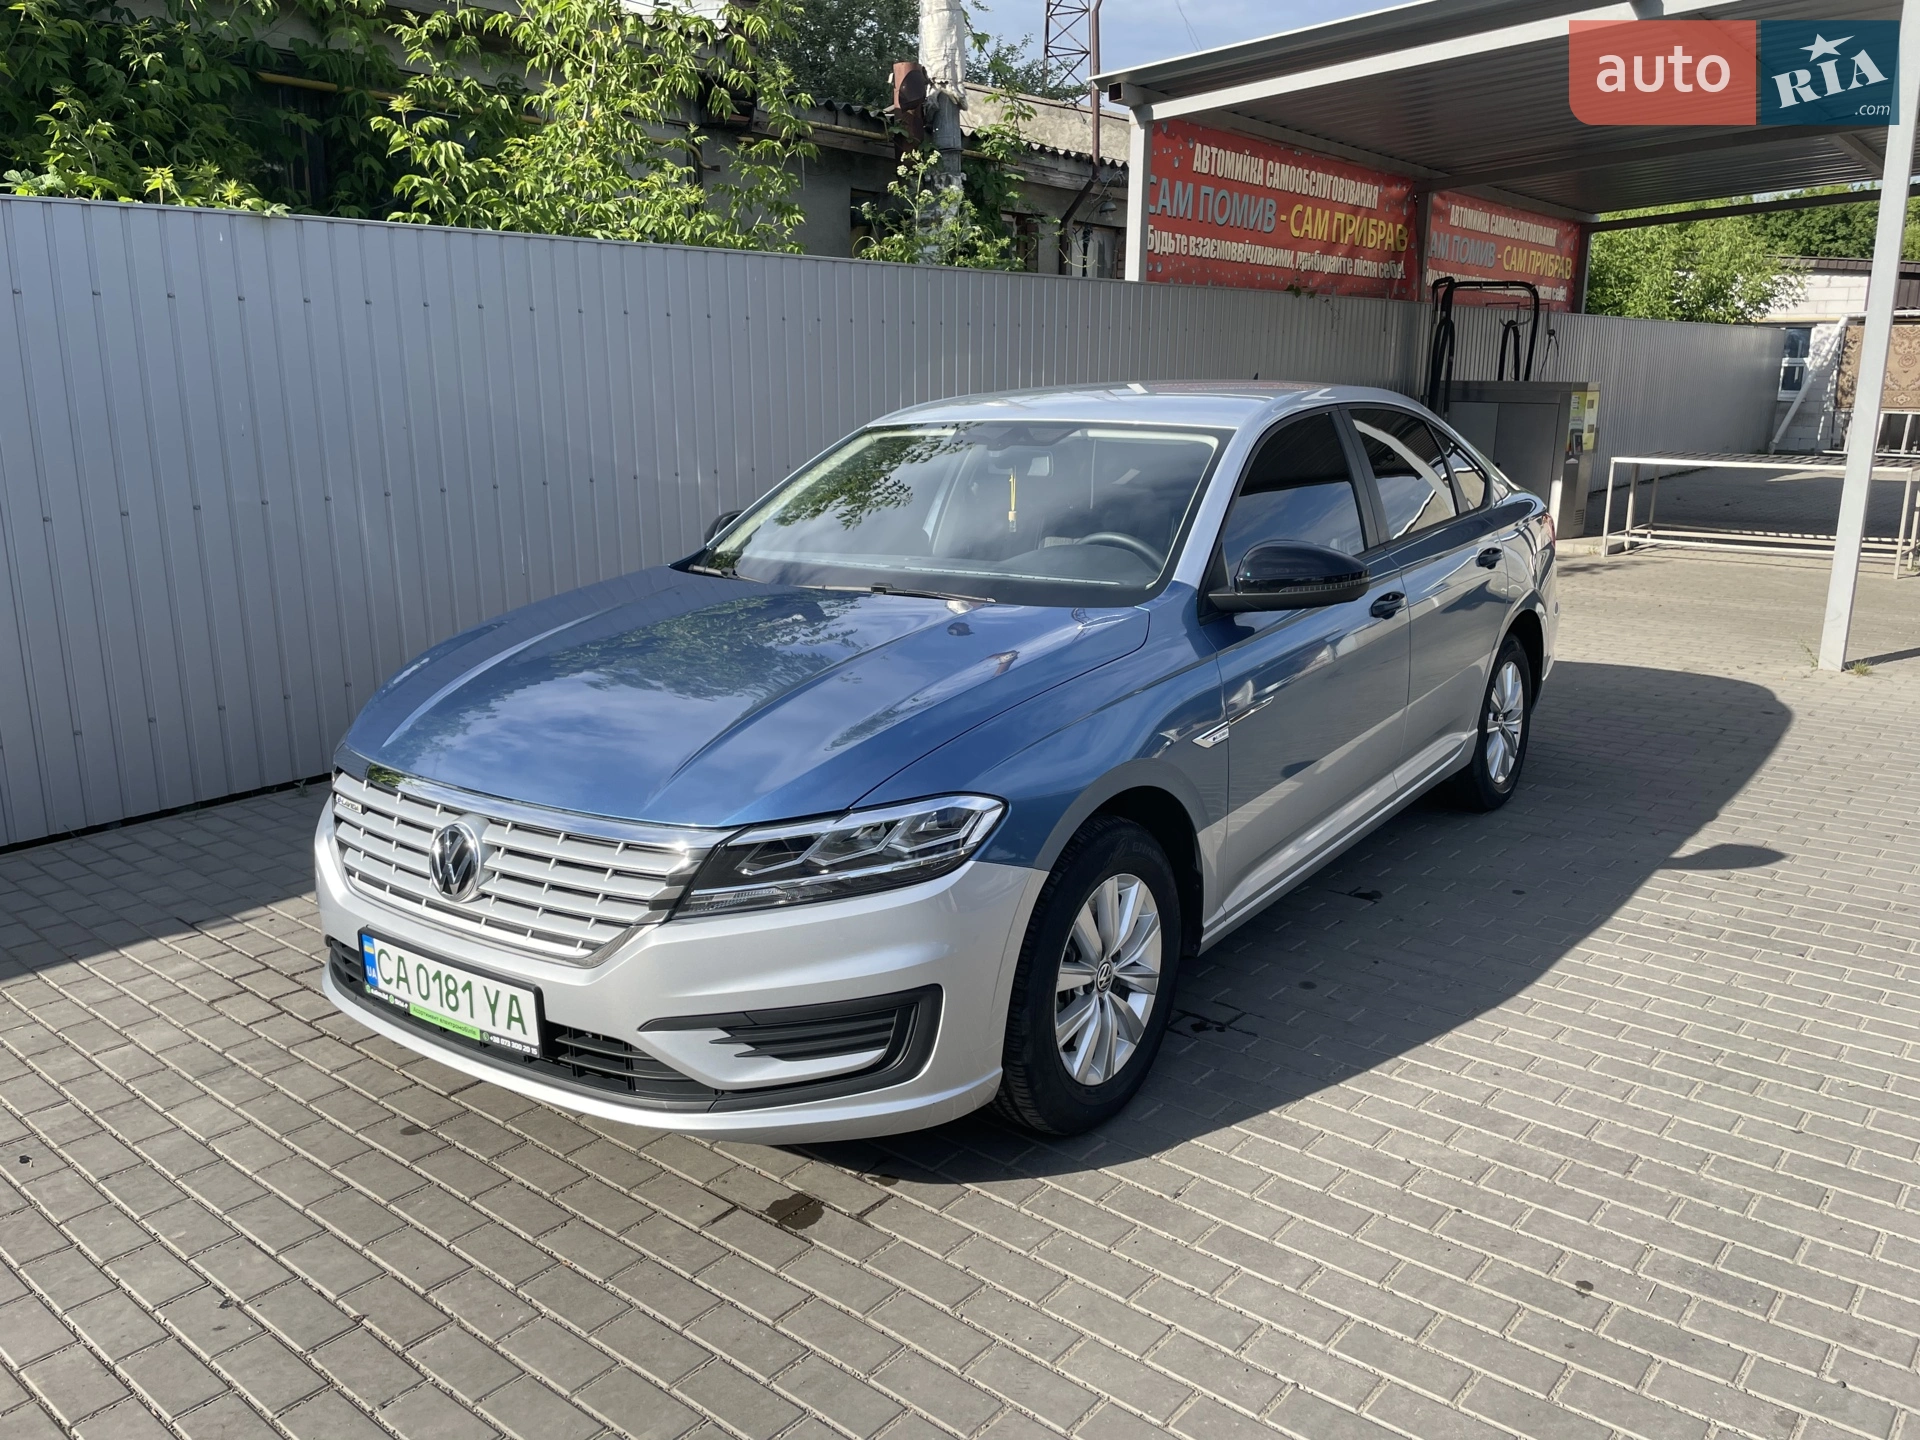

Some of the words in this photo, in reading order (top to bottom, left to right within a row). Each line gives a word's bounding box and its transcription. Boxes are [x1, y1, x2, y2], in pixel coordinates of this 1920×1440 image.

[1193, 142, 1264, 186] АВТОМИЙКА
[1266, 160, 1379, 210] САМООБСЛУГОВУВАННЯ
[1199, 185, 1277, 233] ПОМИВ
[1290, 204, 1330, 242] САМ
[1331, 211, 1409, 252] ПРИБРАВ
[1147, 224, 1188, 257] Будьте
[1296, 250, 1353, 275] прибирайте
[1353, 255, 1378, 278] після
[1378, 259, 1406, 280] себе!
[1428, 231, 1450, 260] АМ
[1451, 235, 1496, 268] ПОМИВ
[1503, 245, 1527, 273] САМ
[1527, 250, 1573, 280] ПРИБРАВ
[366, 965, 378, 980] UA
[377, 948, 412, 995] CA
[416, 963, 475, 1020] 0181
[482, 985, 528, 1036] YA
